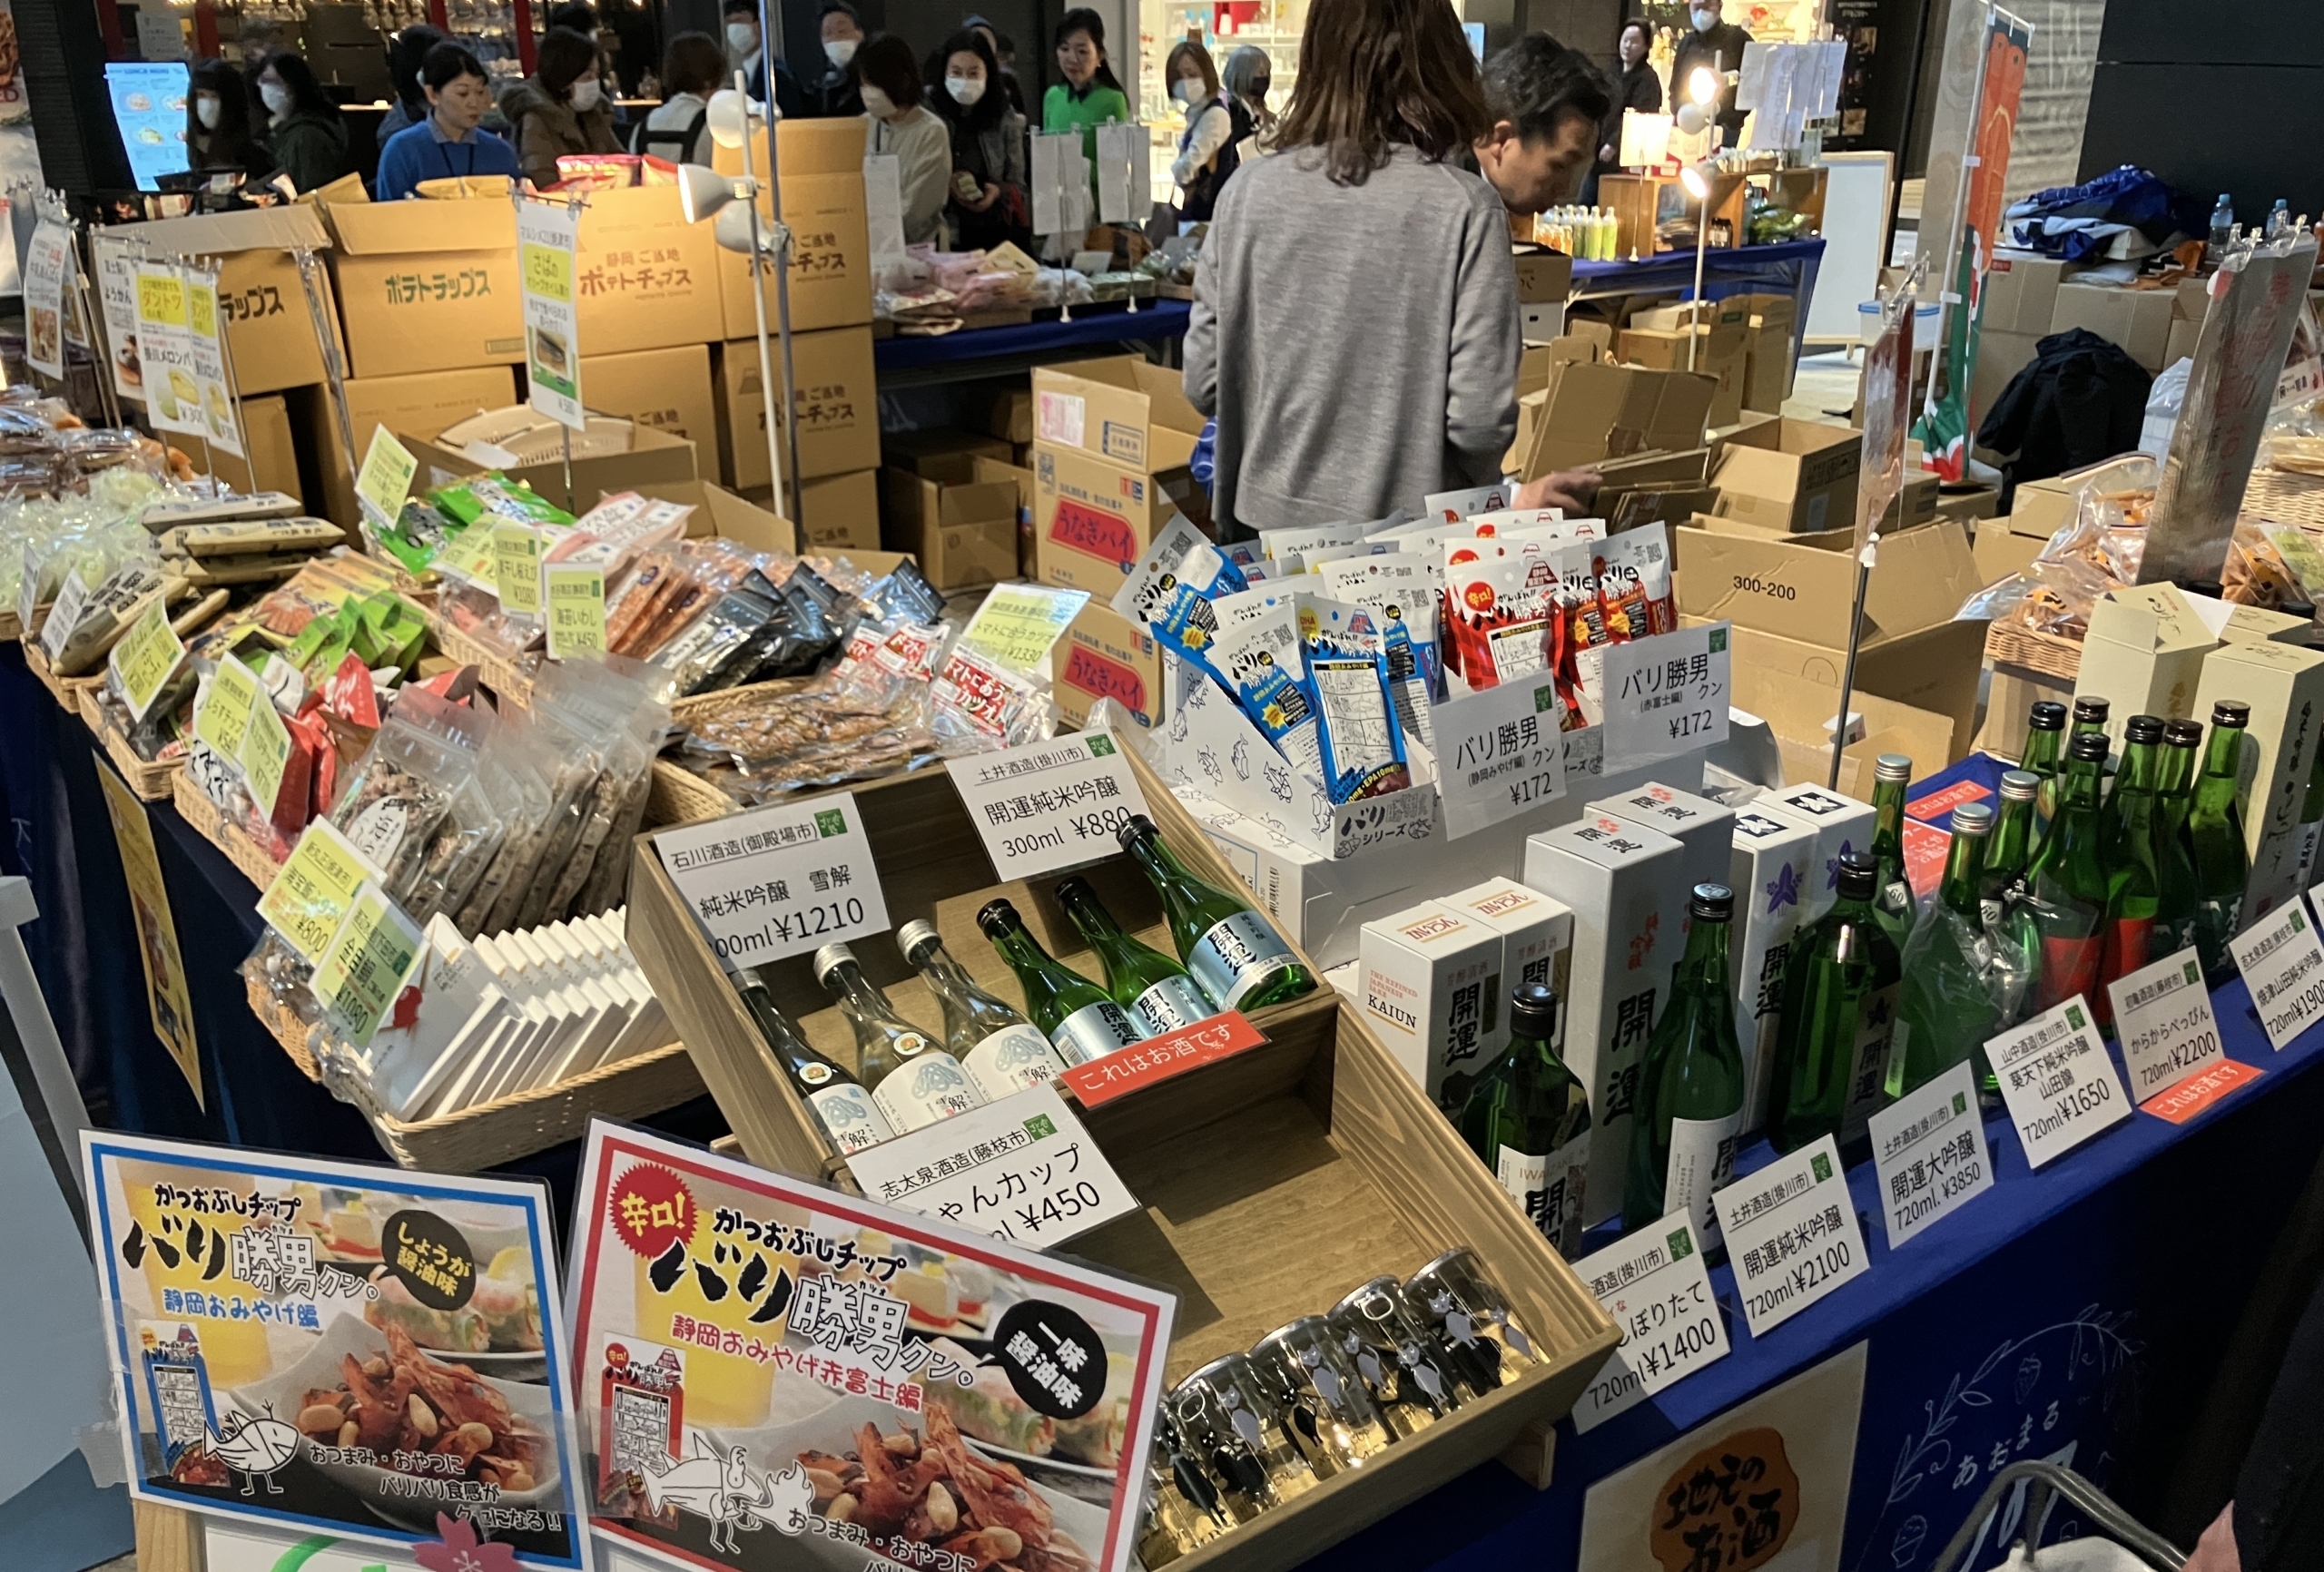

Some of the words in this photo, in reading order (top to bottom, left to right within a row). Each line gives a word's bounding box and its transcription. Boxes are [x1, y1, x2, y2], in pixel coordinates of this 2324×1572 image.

[639, 248, 680, 265] ご当地
[386, 269, 491, 304] ポテトラップス
[580, 266, 693, 297] ポテトチップス
[1059, 508, 1132, 557] うなぎパイ
[1467, 586, 1492, 607] 辛口!
[1733, 575, 1796, 600] 300-200
[1008, 645, 1043, 663] ¥1330
[1621, 653, 1709, 700] バリ勝男
[1073, 654, 1140, 711] うなぎパイ
[1640, 693, 1683, 714] (赤富士編)
[1698, 683, 1723, 700] クン
[1456, 715, 1541, 771] バリ勝男
[1669, 710, 1713, 740] ¥172
[978, 745, 1085, 782] 土井酒造(掛川市)
[1467, 754, 1526, 788] (静岡みやげ編)
[1532, 746, 1555, 768] クン
[984, 774, 1121, 826] 開運純米吟醸
[1510, 772, 1553, 806] ¥172
[670, 821, 818, 869] 石川酒造(御殿場市)
[1002, 826, 1065, 857] 300ml
[1069, 806, 1133, 840] ¥880
[1363, 822, 1408, 846] シリーズ
[699, 879, 791, 920] 純米吟醸
[809, 864, 852, 893] 雪解
[296, 915, 329, 952] ¥800
[1369, 978, 1403, 998] JAPANESE
[1369, 984, 1388, 998] SAKE
[1370, 969, 1384, 981] THE
[1385, 974, 1418, 998] REFINED
[1367, 994, 1418, 1029] KAIUN
[1445, 982, 1482, 1068] 開運
[2266, 979, 2324, 1037] 720ml¥190
[1080, 1022, 1233, 1091] これはお酒です
[2001, 1018, 2067, 1065] 山中酒造(掛川市)
[2009, 1034, 2092, 1092] 葵天下純米吟醸
[2039, 1068, 2075, 1101] 山田錦
[2156, 1065, 2240, 1115] これはお酒です
[1883, 1105, 1950, 1157] 土井酒造(掛川市)
[879, 1127, 1034, 1201] 志太泉酒造(藤枝市)
[1891, 1129, 1976, 1205] 開運大吟醸
[1942, 1161, 1981, 1199] ¥3850
[155, 1184, 301, 1220] かつおぶしチップ
[621, 1190, 687, 1235] 辛口!
[1015, 1181, 1101, 1233] ¥450
[1729, 1171, 1810, 1226] 土井酒造(掛川市)
[397, 1222, 473, 1279] しょうが
[712, 1207, 907, 1282] かつおぶしチップ
[1742, 1204, 1844, 1280] 開運純米吟醸
[163, 1289, 321, 1331] 静岡おみやげ編
[671, 1313, 925, 1413] 静岡おみやげ赤富士編
[1037, 1321, 1089, 1376] 一味
[309, 1443, 465, 1476] おつまみ・おやつに
[379, 1477, 500, 1504] バリバリ食感が
[1662, 1453, 1767, 1530] 地元の
[788, 1507, 978, 1572] おつまみ・おやつに
[1681, 1488, 1782, 1572] お酒
